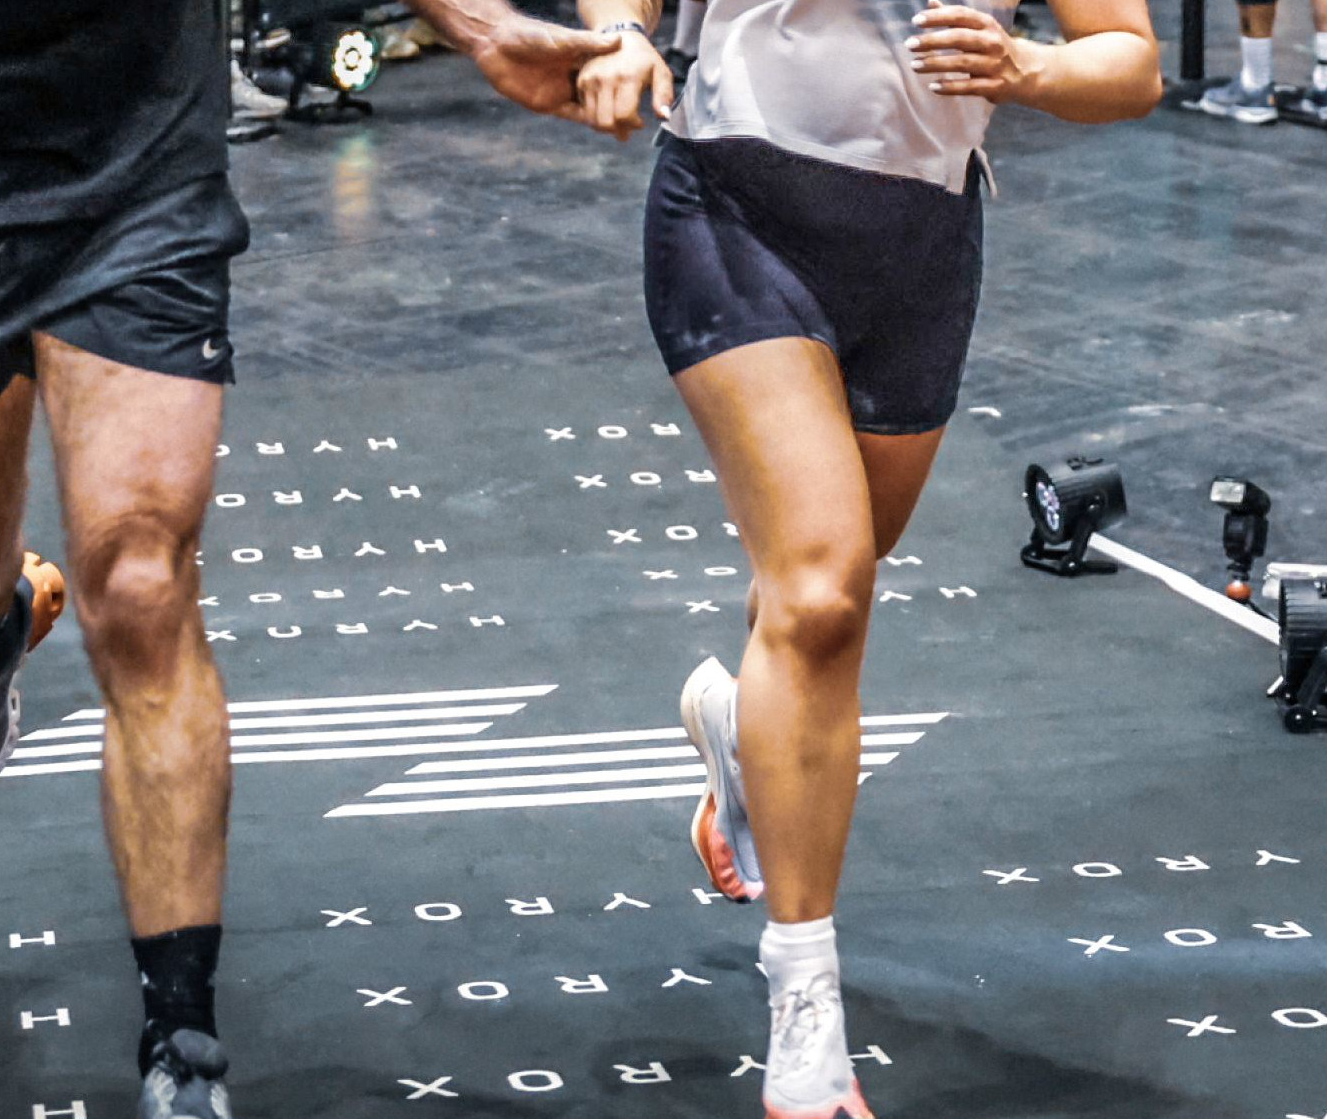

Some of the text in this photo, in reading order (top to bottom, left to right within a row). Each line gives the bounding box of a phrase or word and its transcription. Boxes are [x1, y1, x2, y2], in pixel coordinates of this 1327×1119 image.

[544, 422, 682, 442] ROX
[574, 469, 717, 489] ROX
[215, 485, 422, 508] HYRO
[195, 538, 448, 565] HYRO
[357, 962, 769, 1008] YROX
